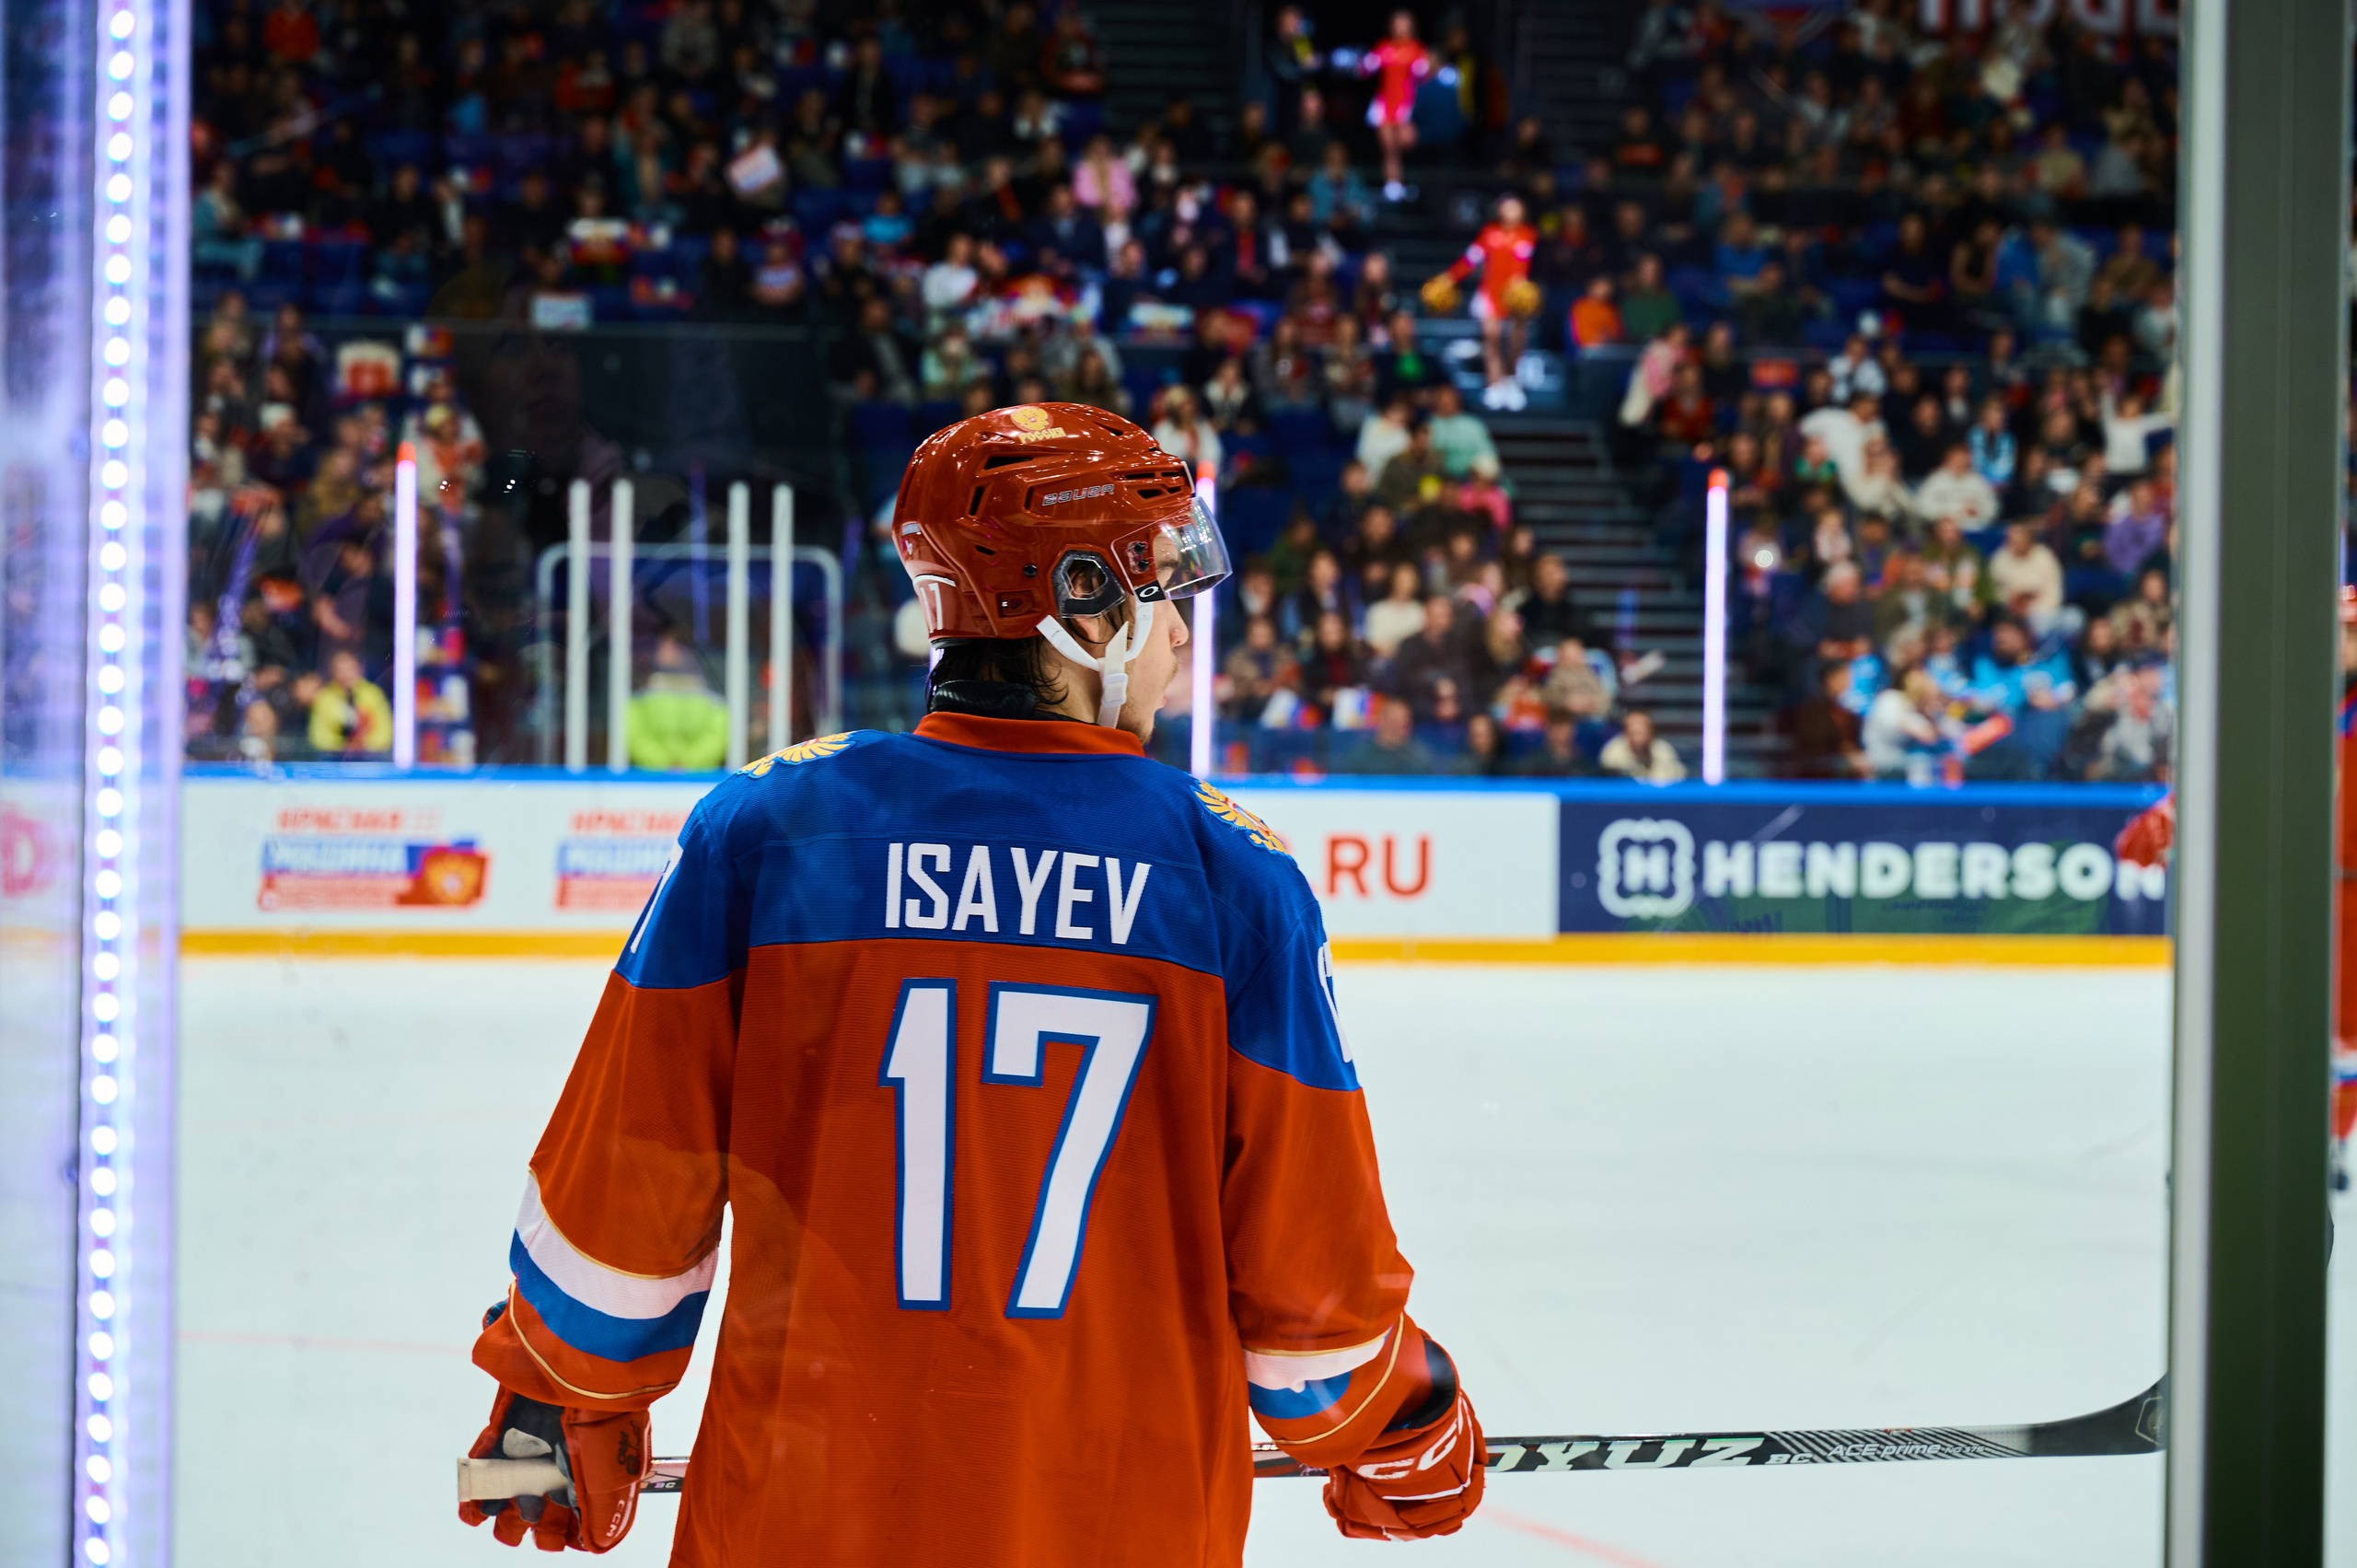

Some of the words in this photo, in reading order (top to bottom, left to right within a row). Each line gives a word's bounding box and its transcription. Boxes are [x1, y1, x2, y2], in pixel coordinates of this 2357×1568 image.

[1018, 427, 1066, 445] РОССИЯ
[1042, 484, 1114, 506] BAUER
[920, 582, 944, 633] 17
[1702, 840, 2166, 901] HENDERSON
[885, 842, 1153, 945] ISAYEV
[878, 978, 1159, 1319] 17
[1765, 1453, 1814, 1465] BC
[1827, 1443, 1879, 1458] ACE
[1880, 1441, 1942, 1458] prime
[606, 1499, 625, 1538] CCM
